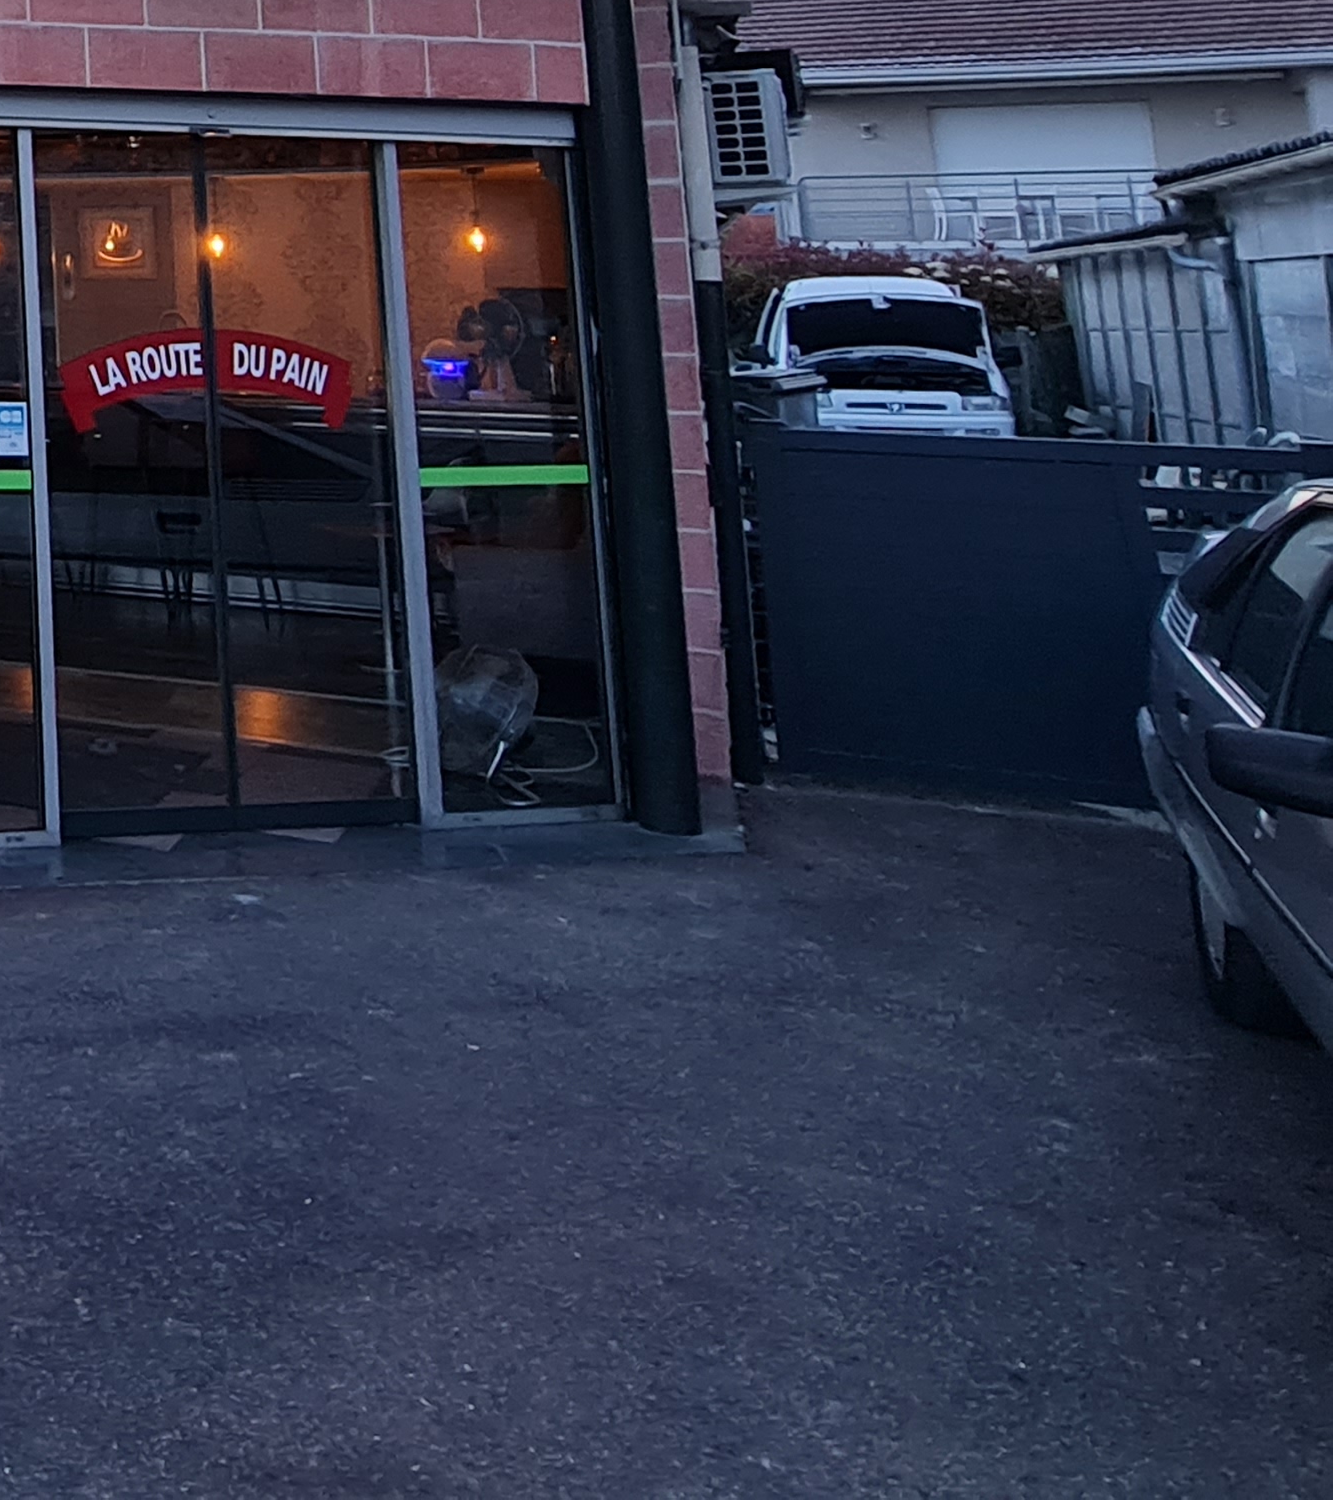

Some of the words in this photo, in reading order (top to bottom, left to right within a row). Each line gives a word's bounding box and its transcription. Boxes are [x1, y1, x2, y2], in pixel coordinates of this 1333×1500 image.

[89, 356, 127, 396] LA
[125, 342, 203, 385] ROUTE
[233, 342, 266, 378] DU
[269, 348, 329, 396] PAIN
